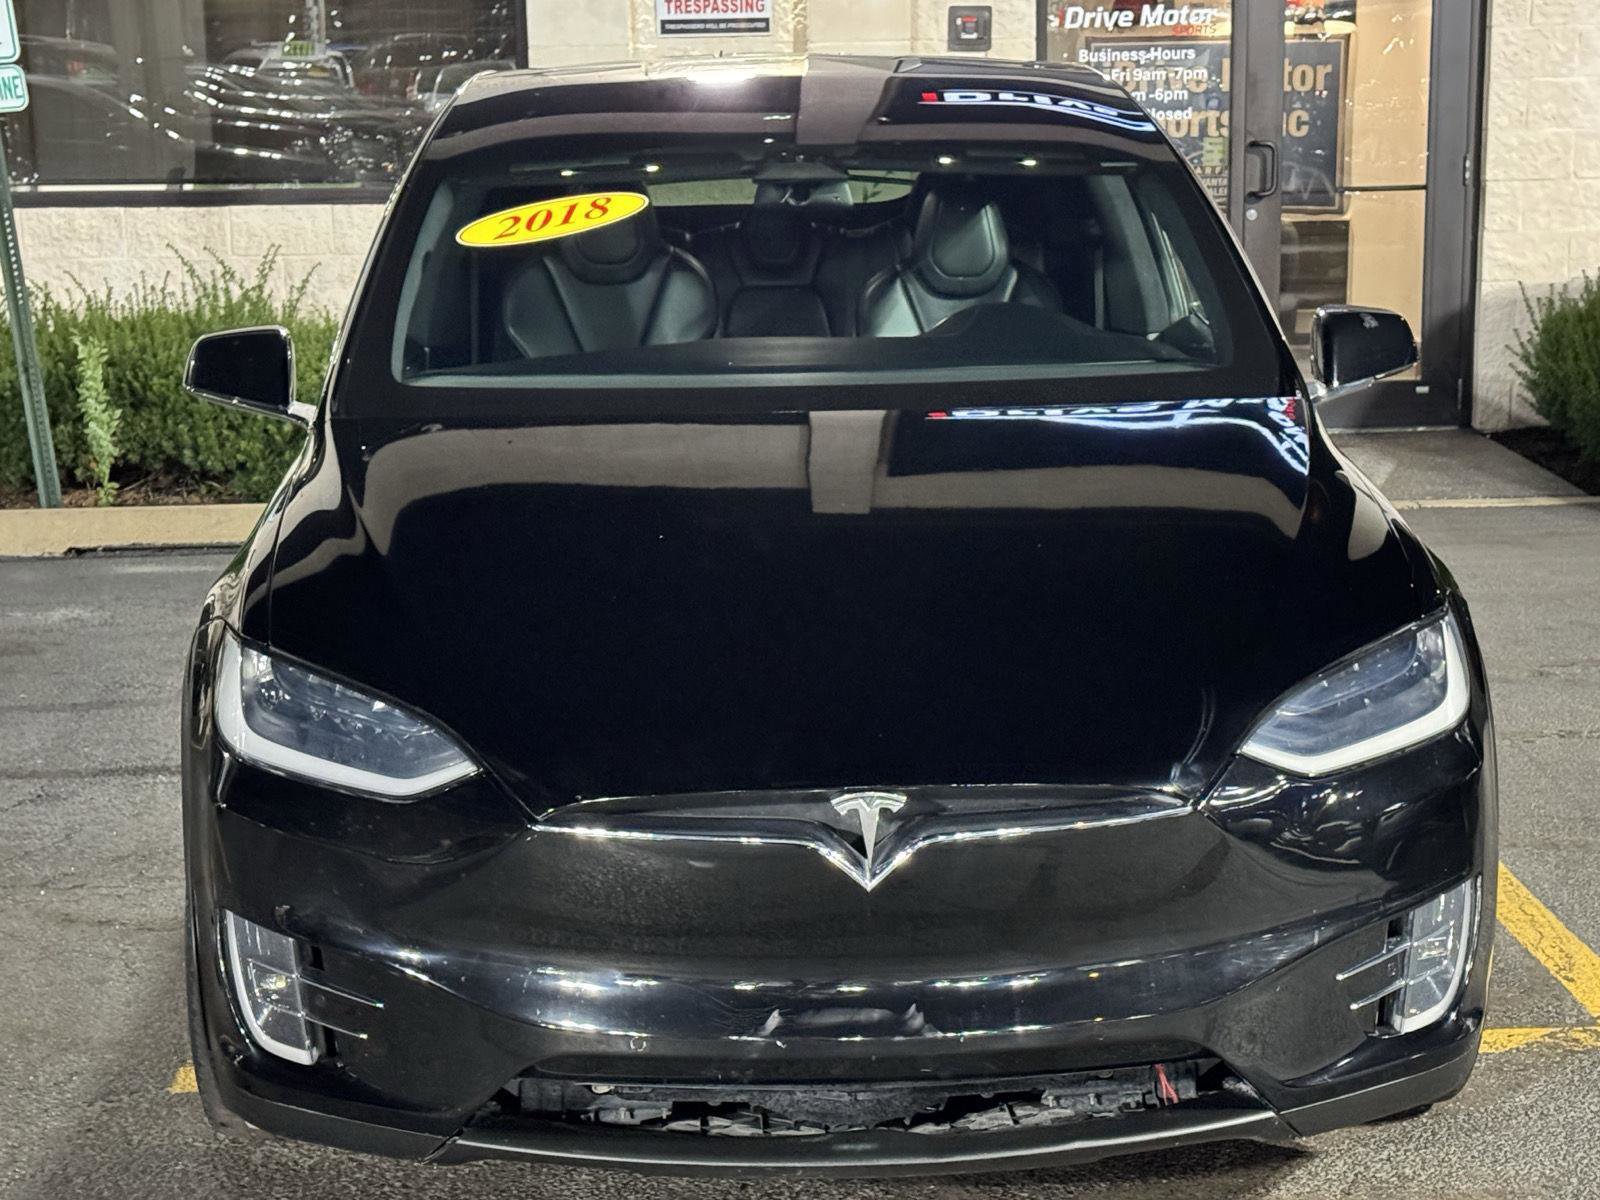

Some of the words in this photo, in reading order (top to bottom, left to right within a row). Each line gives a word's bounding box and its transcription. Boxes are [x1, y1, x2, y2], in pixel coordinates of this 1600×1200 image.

[665, 0, 766, 14] TRESPASSING
[1140, 4, 1216, 27] Motor
[1078, 48, 1147, 63] Business
[1151, 47, 1196, 61] Hours
[493, 196, 612, 241] 2018
